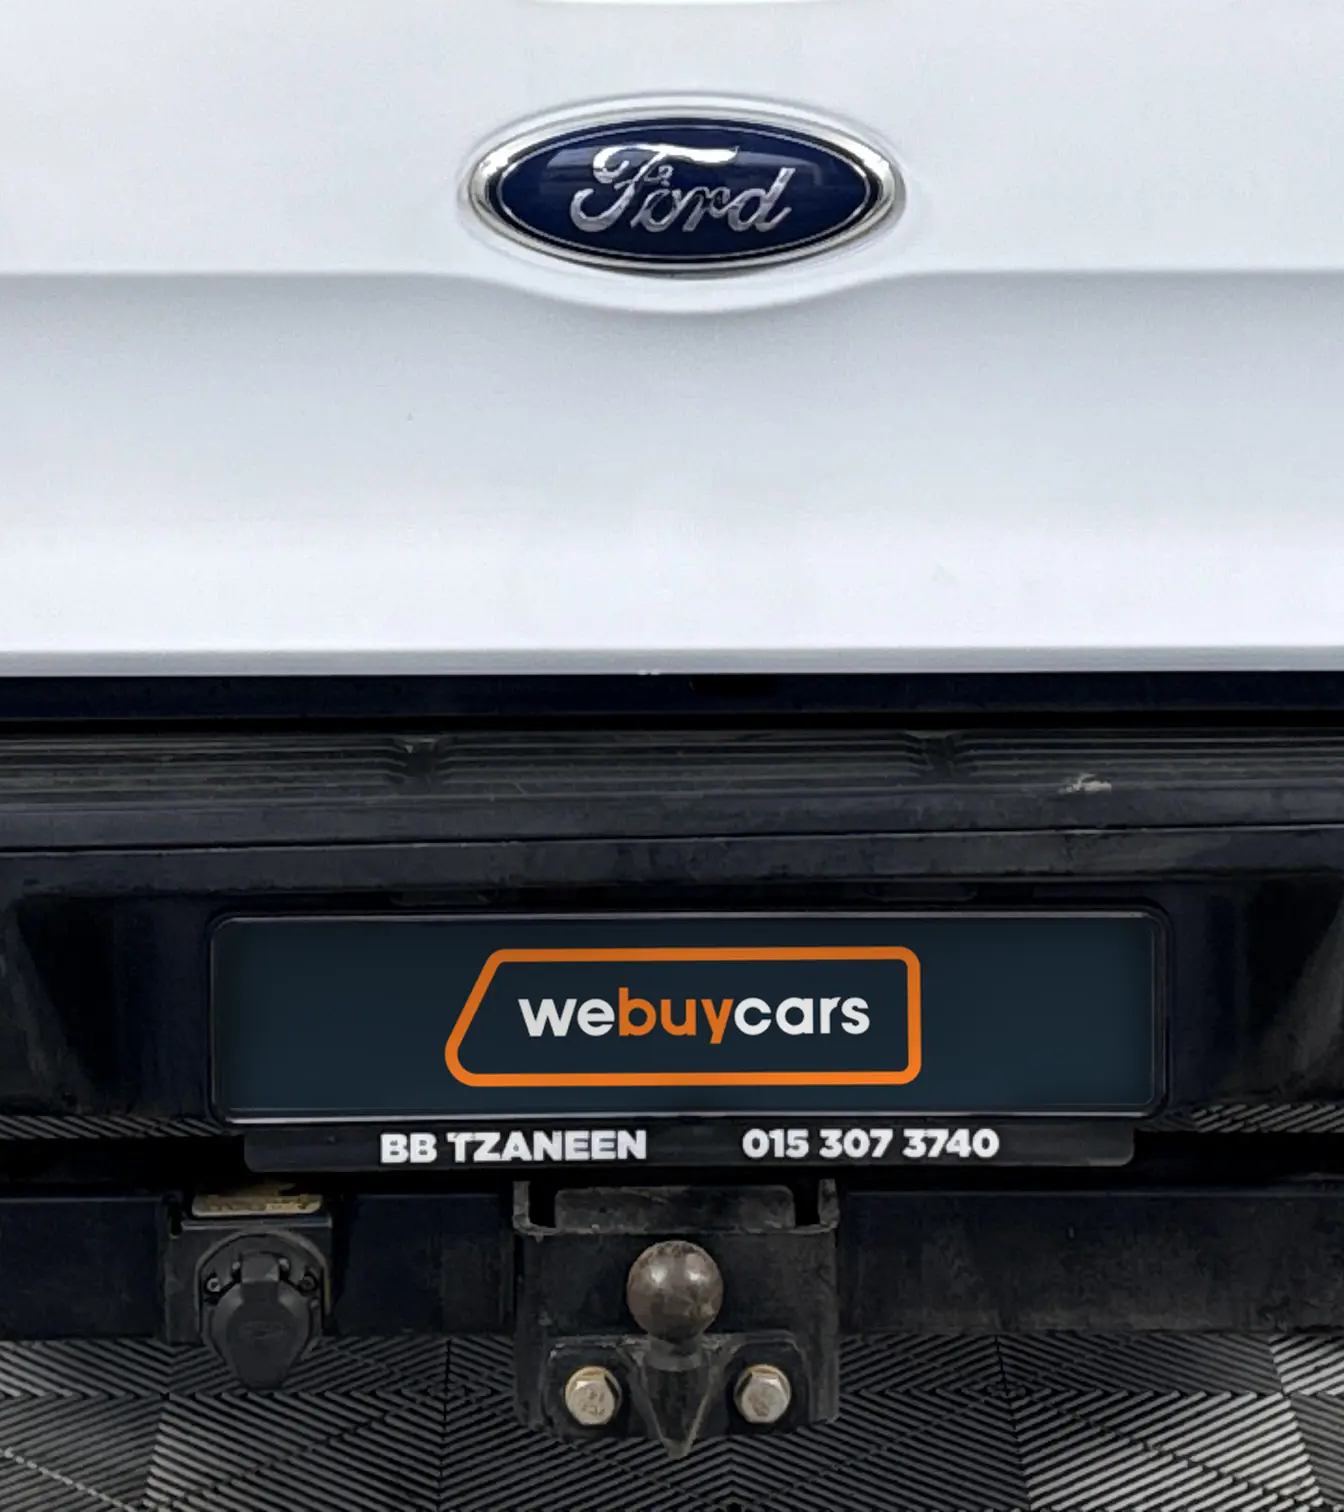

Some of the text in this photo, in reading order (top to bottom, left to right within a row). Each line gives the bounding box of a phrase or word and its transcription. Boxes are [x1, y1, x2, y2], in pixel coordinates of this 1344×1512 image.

[570, 143, 797, 232] Ford
[380, 1128, 1000, 1164] BB TZANEEN 015 307 3740
